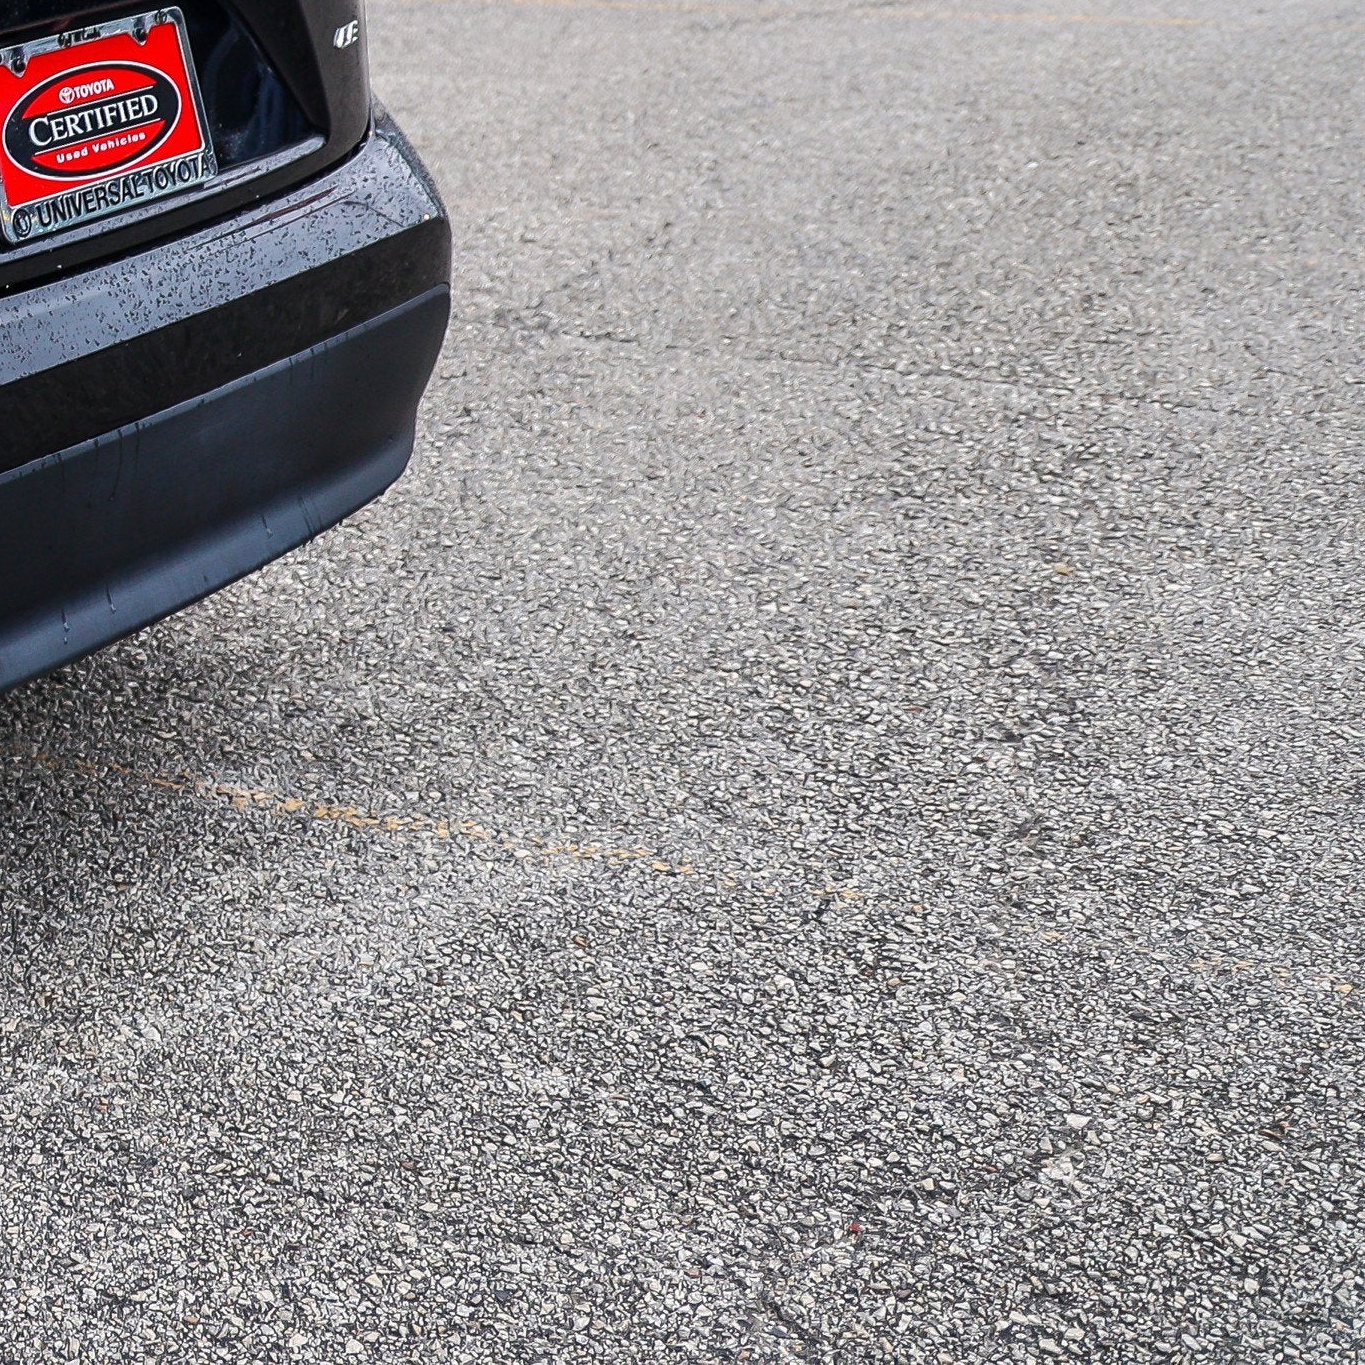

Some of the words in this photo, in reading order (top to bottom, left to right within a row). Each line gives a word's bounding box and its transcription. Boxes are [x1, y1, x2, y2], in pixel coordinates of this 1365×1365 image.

[73, 78, 115, 99] TOYOTA
[28, 93, 159, 146] CERTIFIED
[56, 146, 89, 164] Used
[91, 131, 146, 154] Vehicles
[35, 174, 145, 227] UNIVERSAL
[142, 153, 211, 194] TOYOTA
